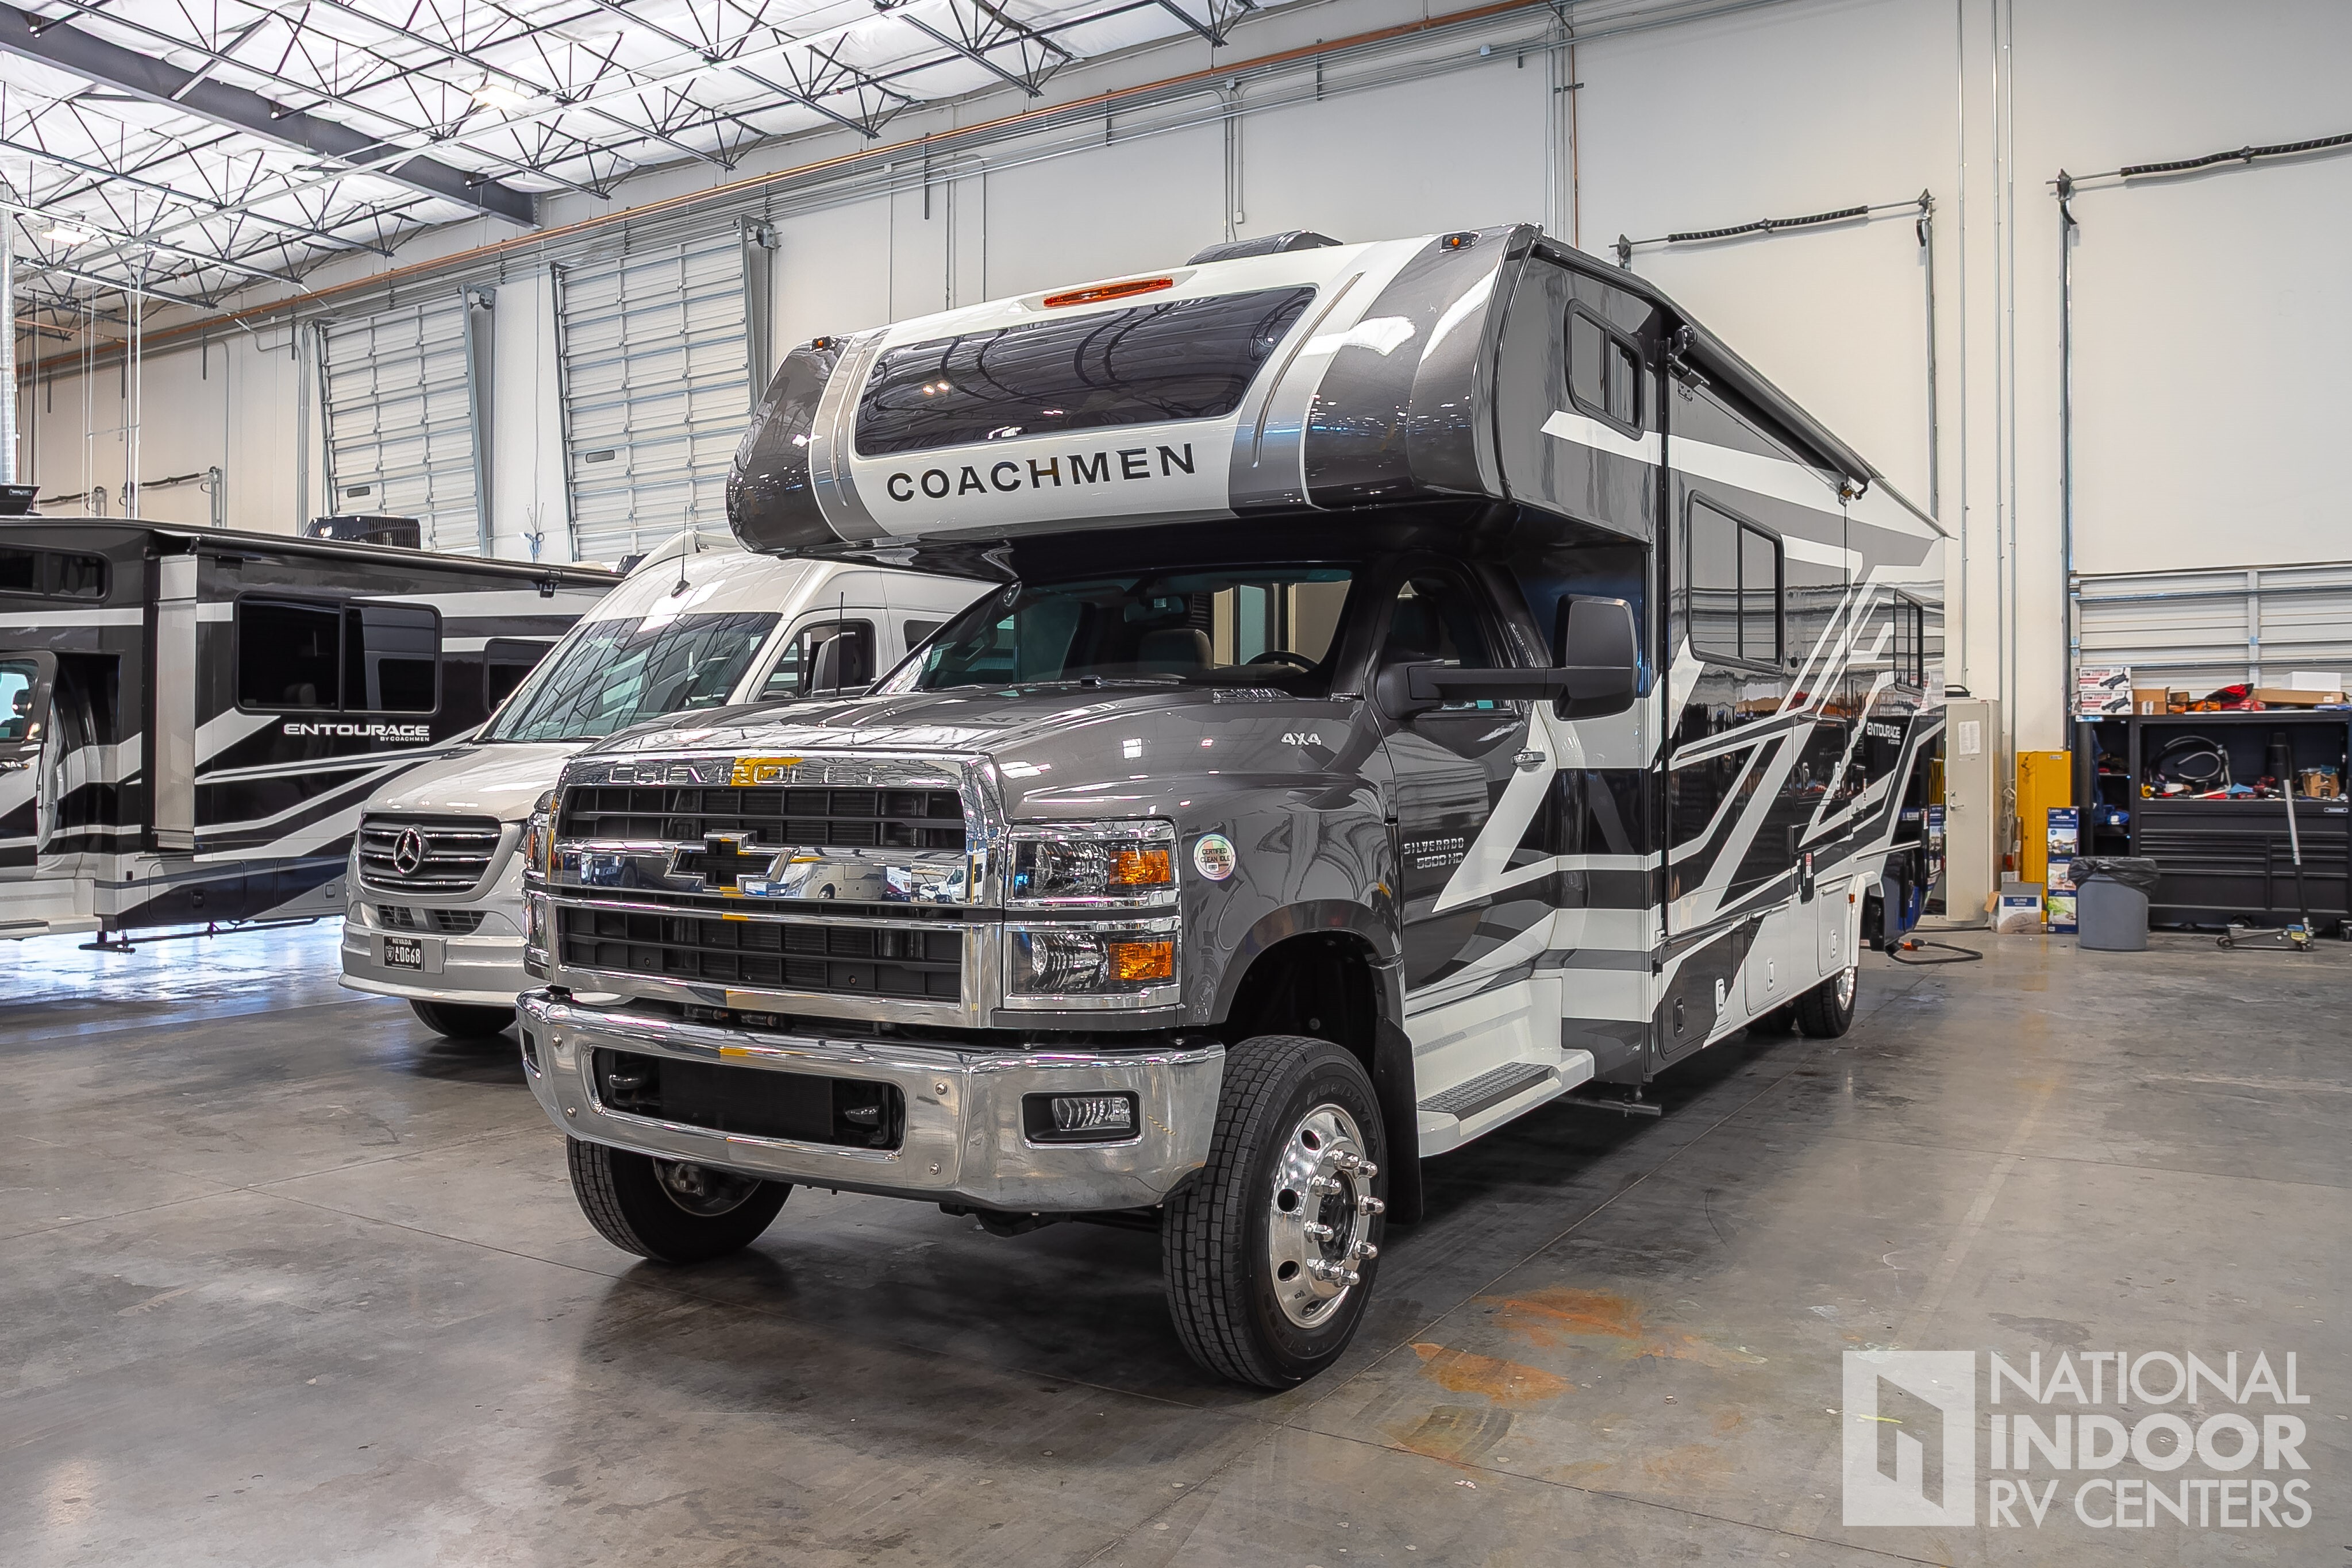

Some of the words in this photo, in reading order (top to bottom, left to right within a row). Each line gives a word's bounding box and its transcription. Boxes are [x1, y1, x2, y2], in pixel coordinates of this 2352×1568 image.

[887, 442, 1196, 502] COACHMEN
[284, 723, 430, 736] ENTOURAGE
[1281, 733, 1322, 745] 4X4
[1202, 847, 1227, 856] CERTIFIED
[1404, 837, 1464, 855] SILVERADO
[1416, 854, 1447, 869] 5500
[1448, 852, 1464, 865] HD
[392, 937, 413, 946] NEVADA
